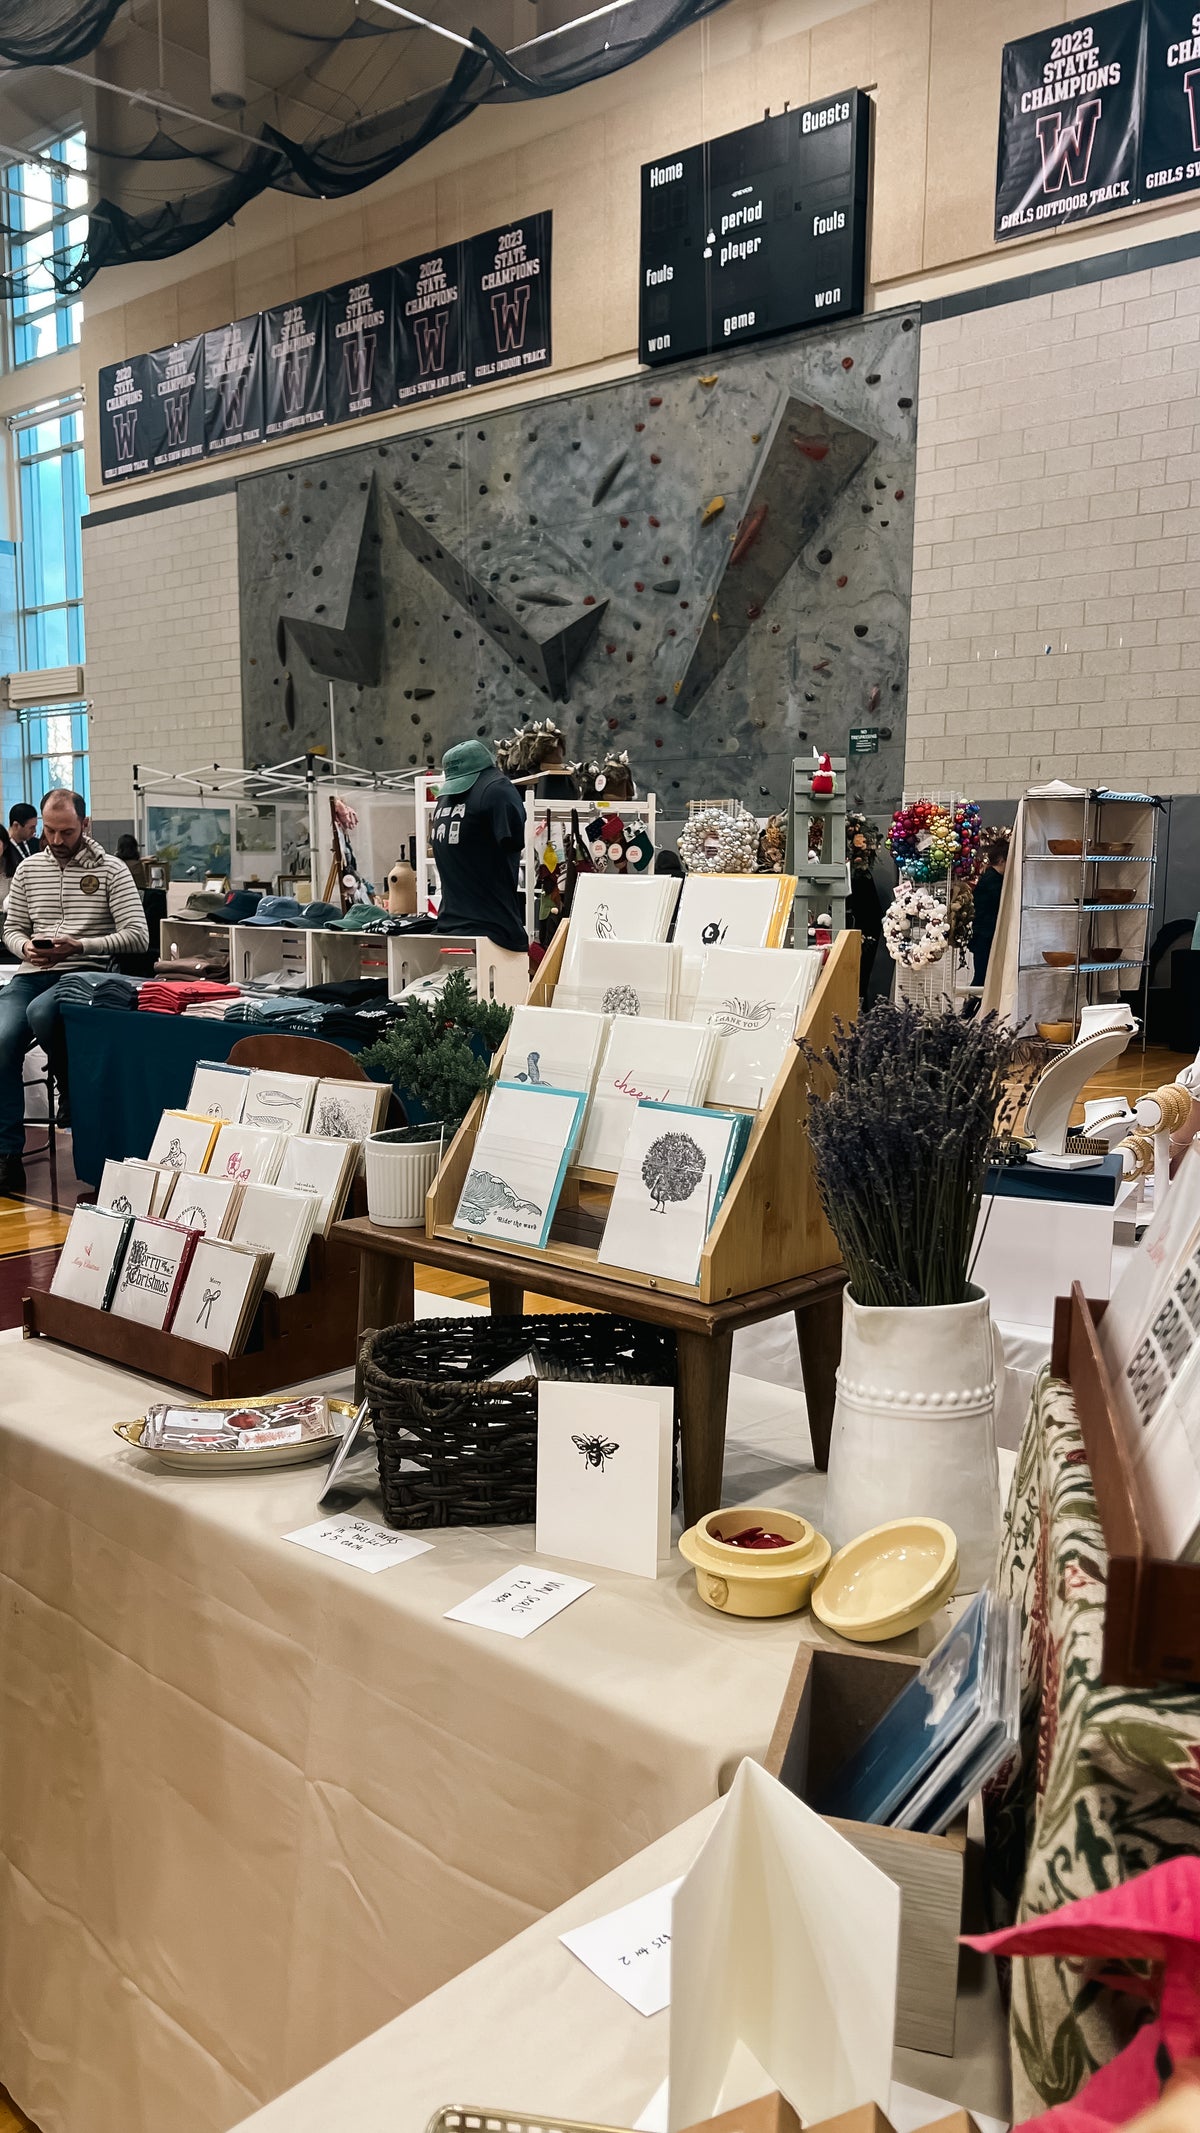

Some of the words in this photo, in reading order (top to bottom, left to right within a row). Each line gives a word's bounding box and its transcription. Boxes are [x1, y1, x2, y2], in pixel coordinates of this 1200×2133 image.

[1050, 26, 1094, 60] 2023
[1043, 46, 1099, 84] STATE
[1021, 62, 1121, 114] CHAMPIONS
[802, 102, 850, 134] Guests
[1036, 98, 1102, 193] W
[650, 162, 683, 188] Home
[1146, 165, 1184, 189] GIRLS
[721, 200, 762, 235] period
[1000, 207, 1034, 232] GIRLS
[1036, 192, 1088, 220] OUTDOOR
[1090, 180, 1130, 206] TRACK
[813, 210, 845, 236] fouls
[498, 229, 523, 251] 2023
[720, 237, 761, 267] player
[420, 258, 443, 279] 2022
[494, 245, 527, 269] STATE
[416, 273, 447, 296] STATE
[481, 258, 540, 291] CHAMPIONS
[646, 264, 673, 286] fouls
[346, 298, 373, 319] STATE
[405, 286, 458, 316] CHAMPIONS
[814, 288, 841, 308] won
[335, 310, 384, 338] CHAMPIONS
[490, 284, 530, 353] W
[724, 311, 755, 336] game
[413, 311, 449, 375] W
[647, 334, 671, 352] won
[343, 333, 377, 395] W
[475, 363, 495, 377] GIRLS
[523, 349, 546, 365] TRACK
[164, 391, 190, 447] W
[113, 408, 138, 461] W
[743, 1021, 759, 1029] YOU
[128, 1239, 161, 1272] Merry
[126, 1266, 170, 1294] Christmas
[618, 1956, 631, 1966] 2
